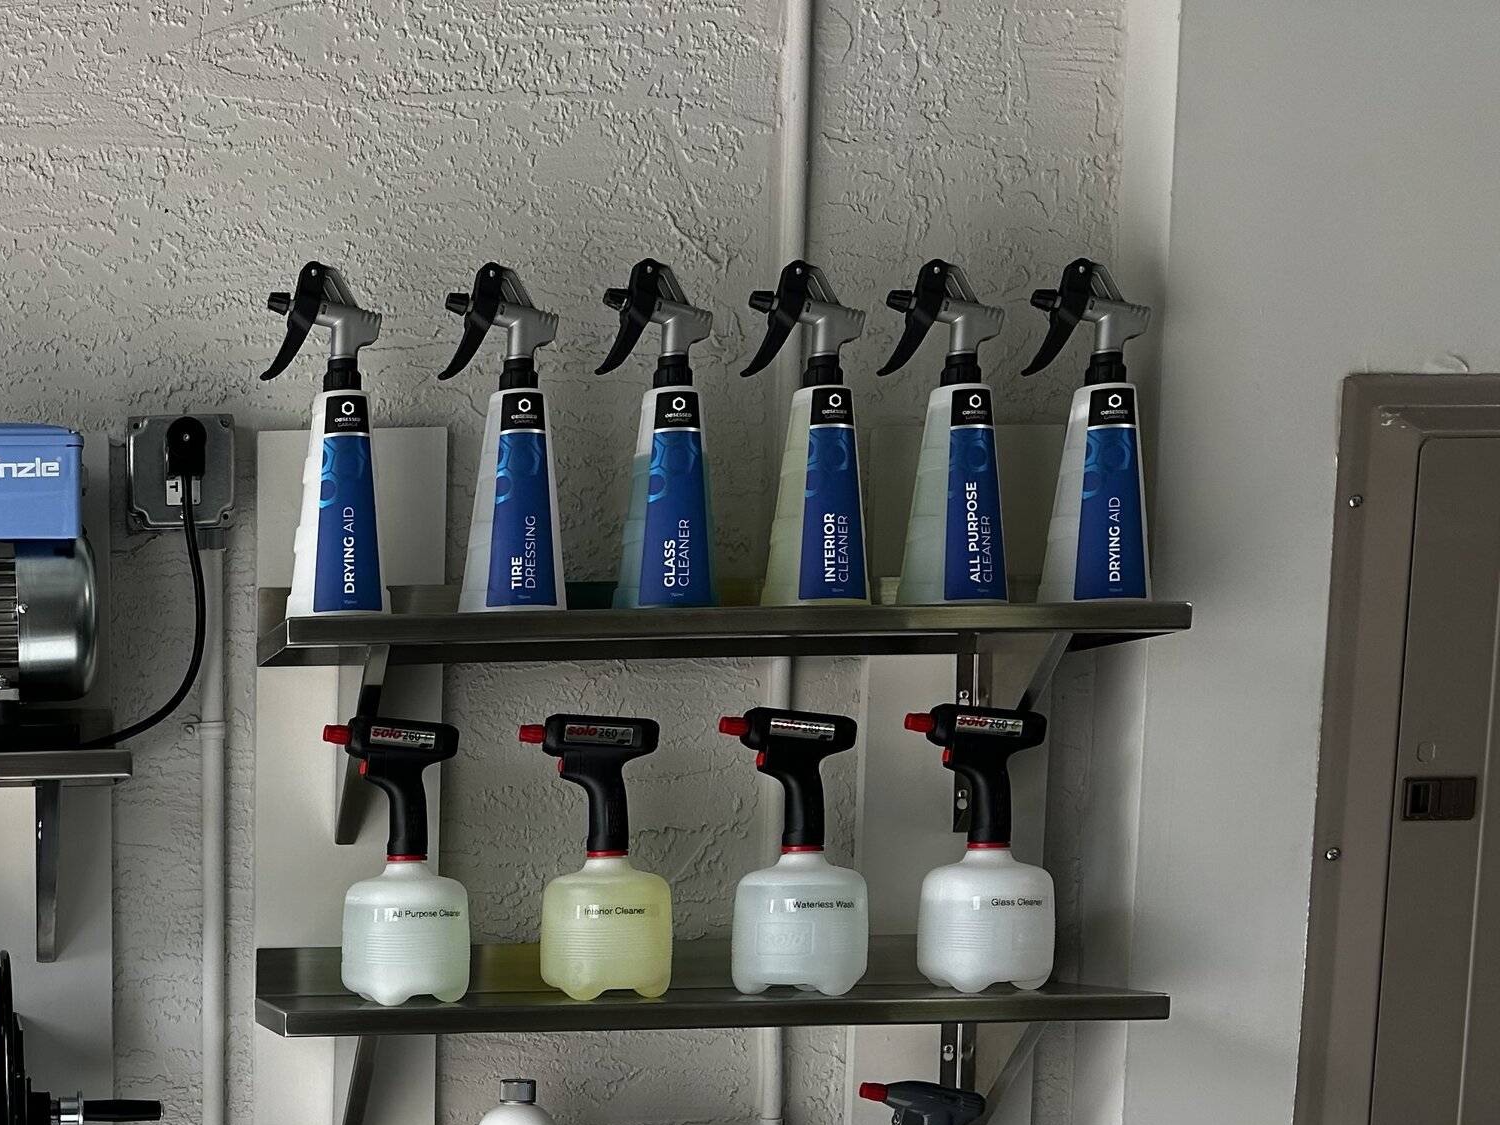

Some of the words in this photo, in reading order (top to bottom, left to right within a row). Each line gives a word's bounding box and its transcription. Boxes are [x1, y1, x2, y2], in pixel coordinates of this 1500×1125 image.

[343, 506, 355, 533] AID
[965, 481, 980, 552] PURPOSE
[1108, 497, 1121, 522] AID
[343, 537, 355, 594] DRYING
[525, 515, 536, 589] DRESSING
[664, 539, 676, 587] GLASS
[678, 519, 690, 587] CLEANER
[823, 513, 836, 582] INTERIOR
[837, 515, 849, 583] CLEANER
[980, 515, 993, 583] CLEANER
[1108, 526, 1121, 582] DRYING
[511, 556, 523, 590] TIRE
[969, 555, 981, 583] ALL
[567, 726, 597, 737] solo
[598, 728, 618, 737] 260
[405, 910, 438, 918] Purpose
[615, 907, 646, 915] Cleaner
[793, 901, 834, 909] Waterless
[991, 898, 1016, 906] Glass
